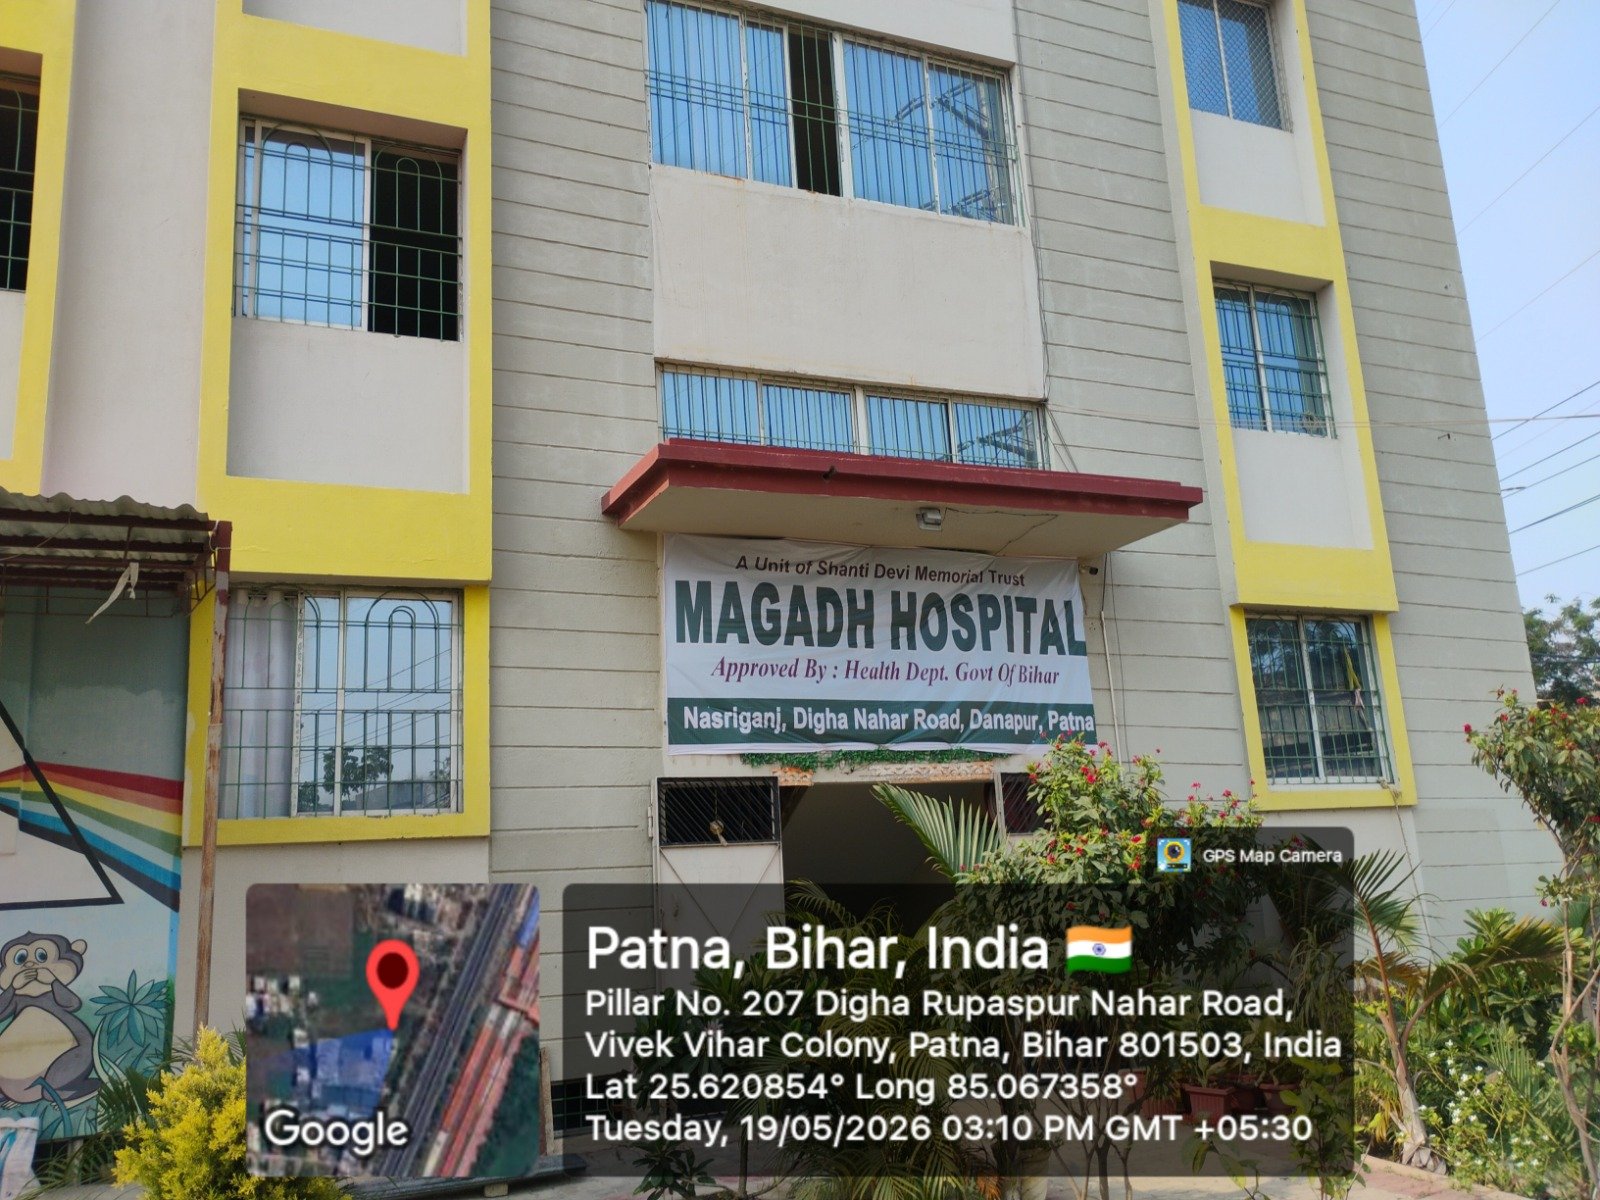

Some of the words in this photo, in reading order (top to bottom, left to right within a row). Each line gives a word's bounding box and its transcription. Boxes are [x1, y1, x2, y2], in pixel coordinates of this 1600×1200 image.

[735, 555, 748, 570] A
[755, 557, 790, 573] Unit
[795, 560, 812, 574] of
[816, 560, 869, 578] Shanti
[874, 563, 910, 580] Devi
[915, 565, 983, 584] Memorial
[988, 570, 1025, 587] Trust
[675, 580, 875, 649] MAGADH
[890, 590, 1087, 656] HOSPITAL
[711, 656, 800, 682] Approved
[844, 659, 901, 681] Health
[905, 661, 949, 686] Dept.
[955, 661, 993, 682] Govt
[998, 662, 1016, 687] Of
[1019, 665, 1060, 684] Bihar
[683, 706, 787, 734] Nasriganj,
[793, 706, 849, 734] Digha
[853, 707, 909, 730] Nahar
[913, 708, 965, 733] Road,
[969, 708, 1043, 734] Danapur,
[1047, 710, 1095, 731] Patna
